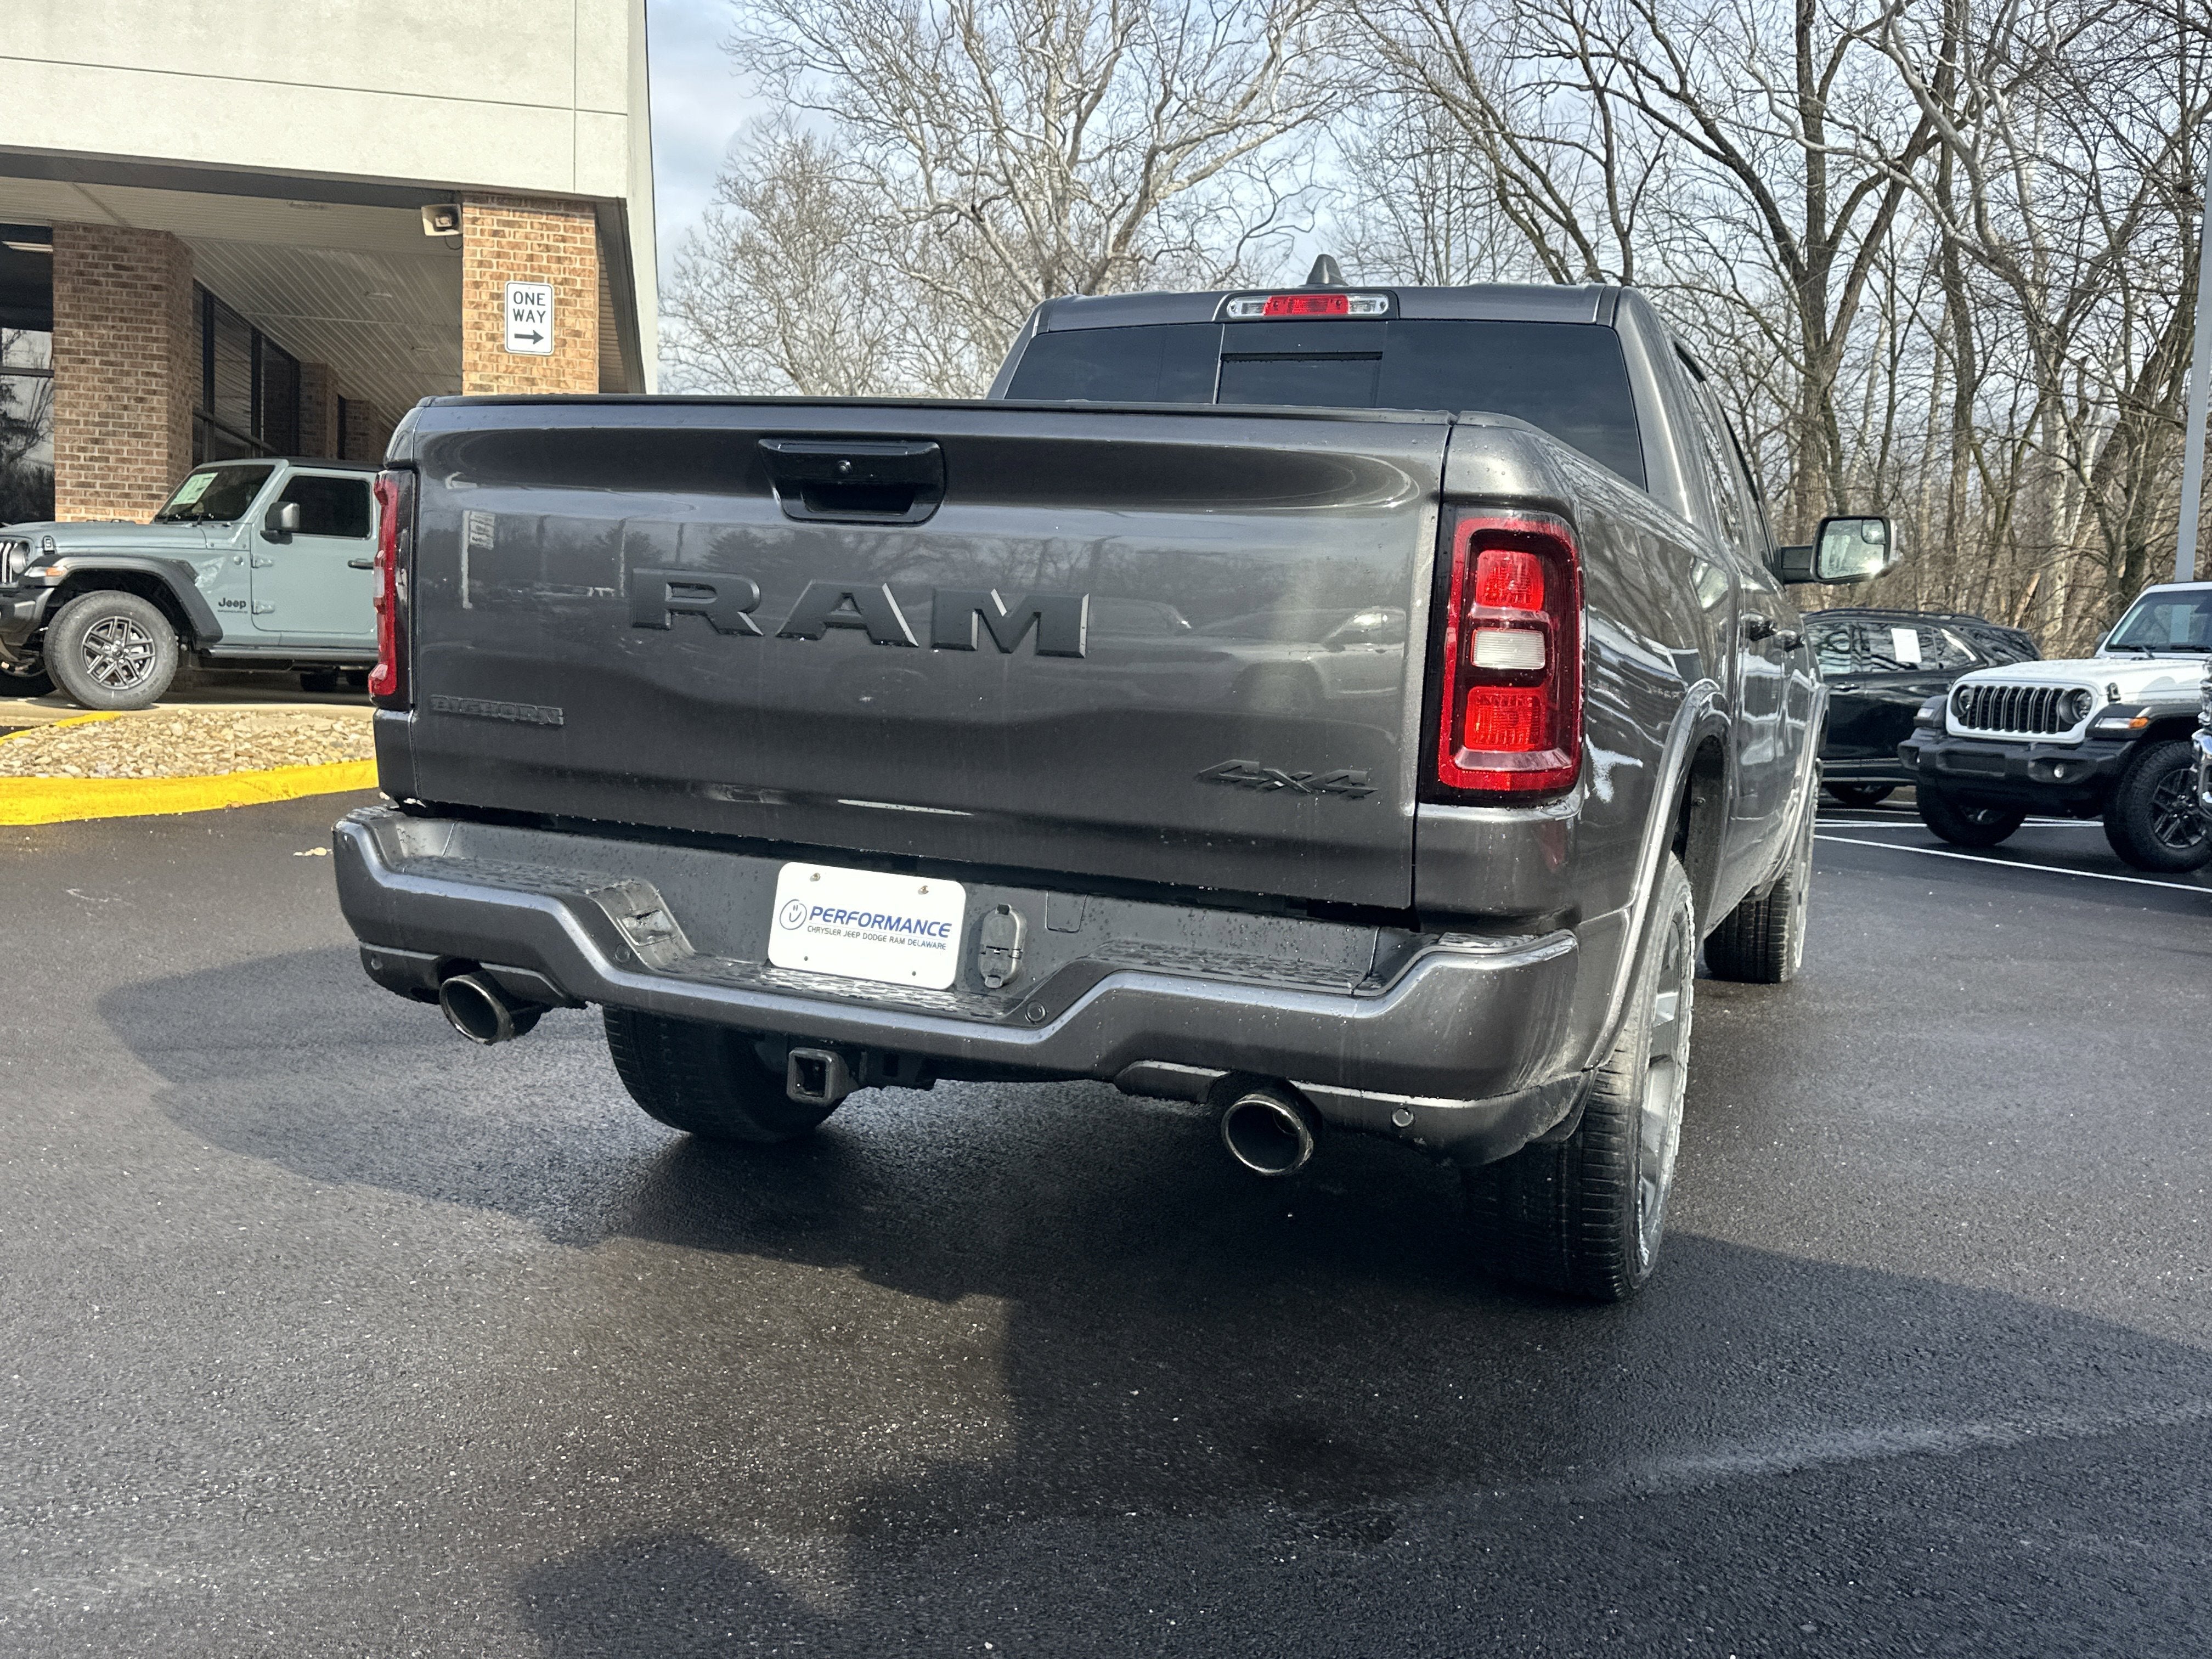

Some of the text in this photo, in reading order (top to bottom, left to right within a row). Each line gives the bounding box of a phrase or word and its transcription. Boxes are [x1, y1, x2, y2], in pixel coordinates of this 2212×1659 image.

[514, 291, 546, 306] ONE
[513, 308, 546, 323] WAY
[218, 597, 246, 610] Jeep
[631, 567, 1090, 658] RAM
[809, 906, 952, 938] PERFORMANCE
[807, 925, 946, 950] CHRYSLER JEEP DODGE RAM DELAWARE
